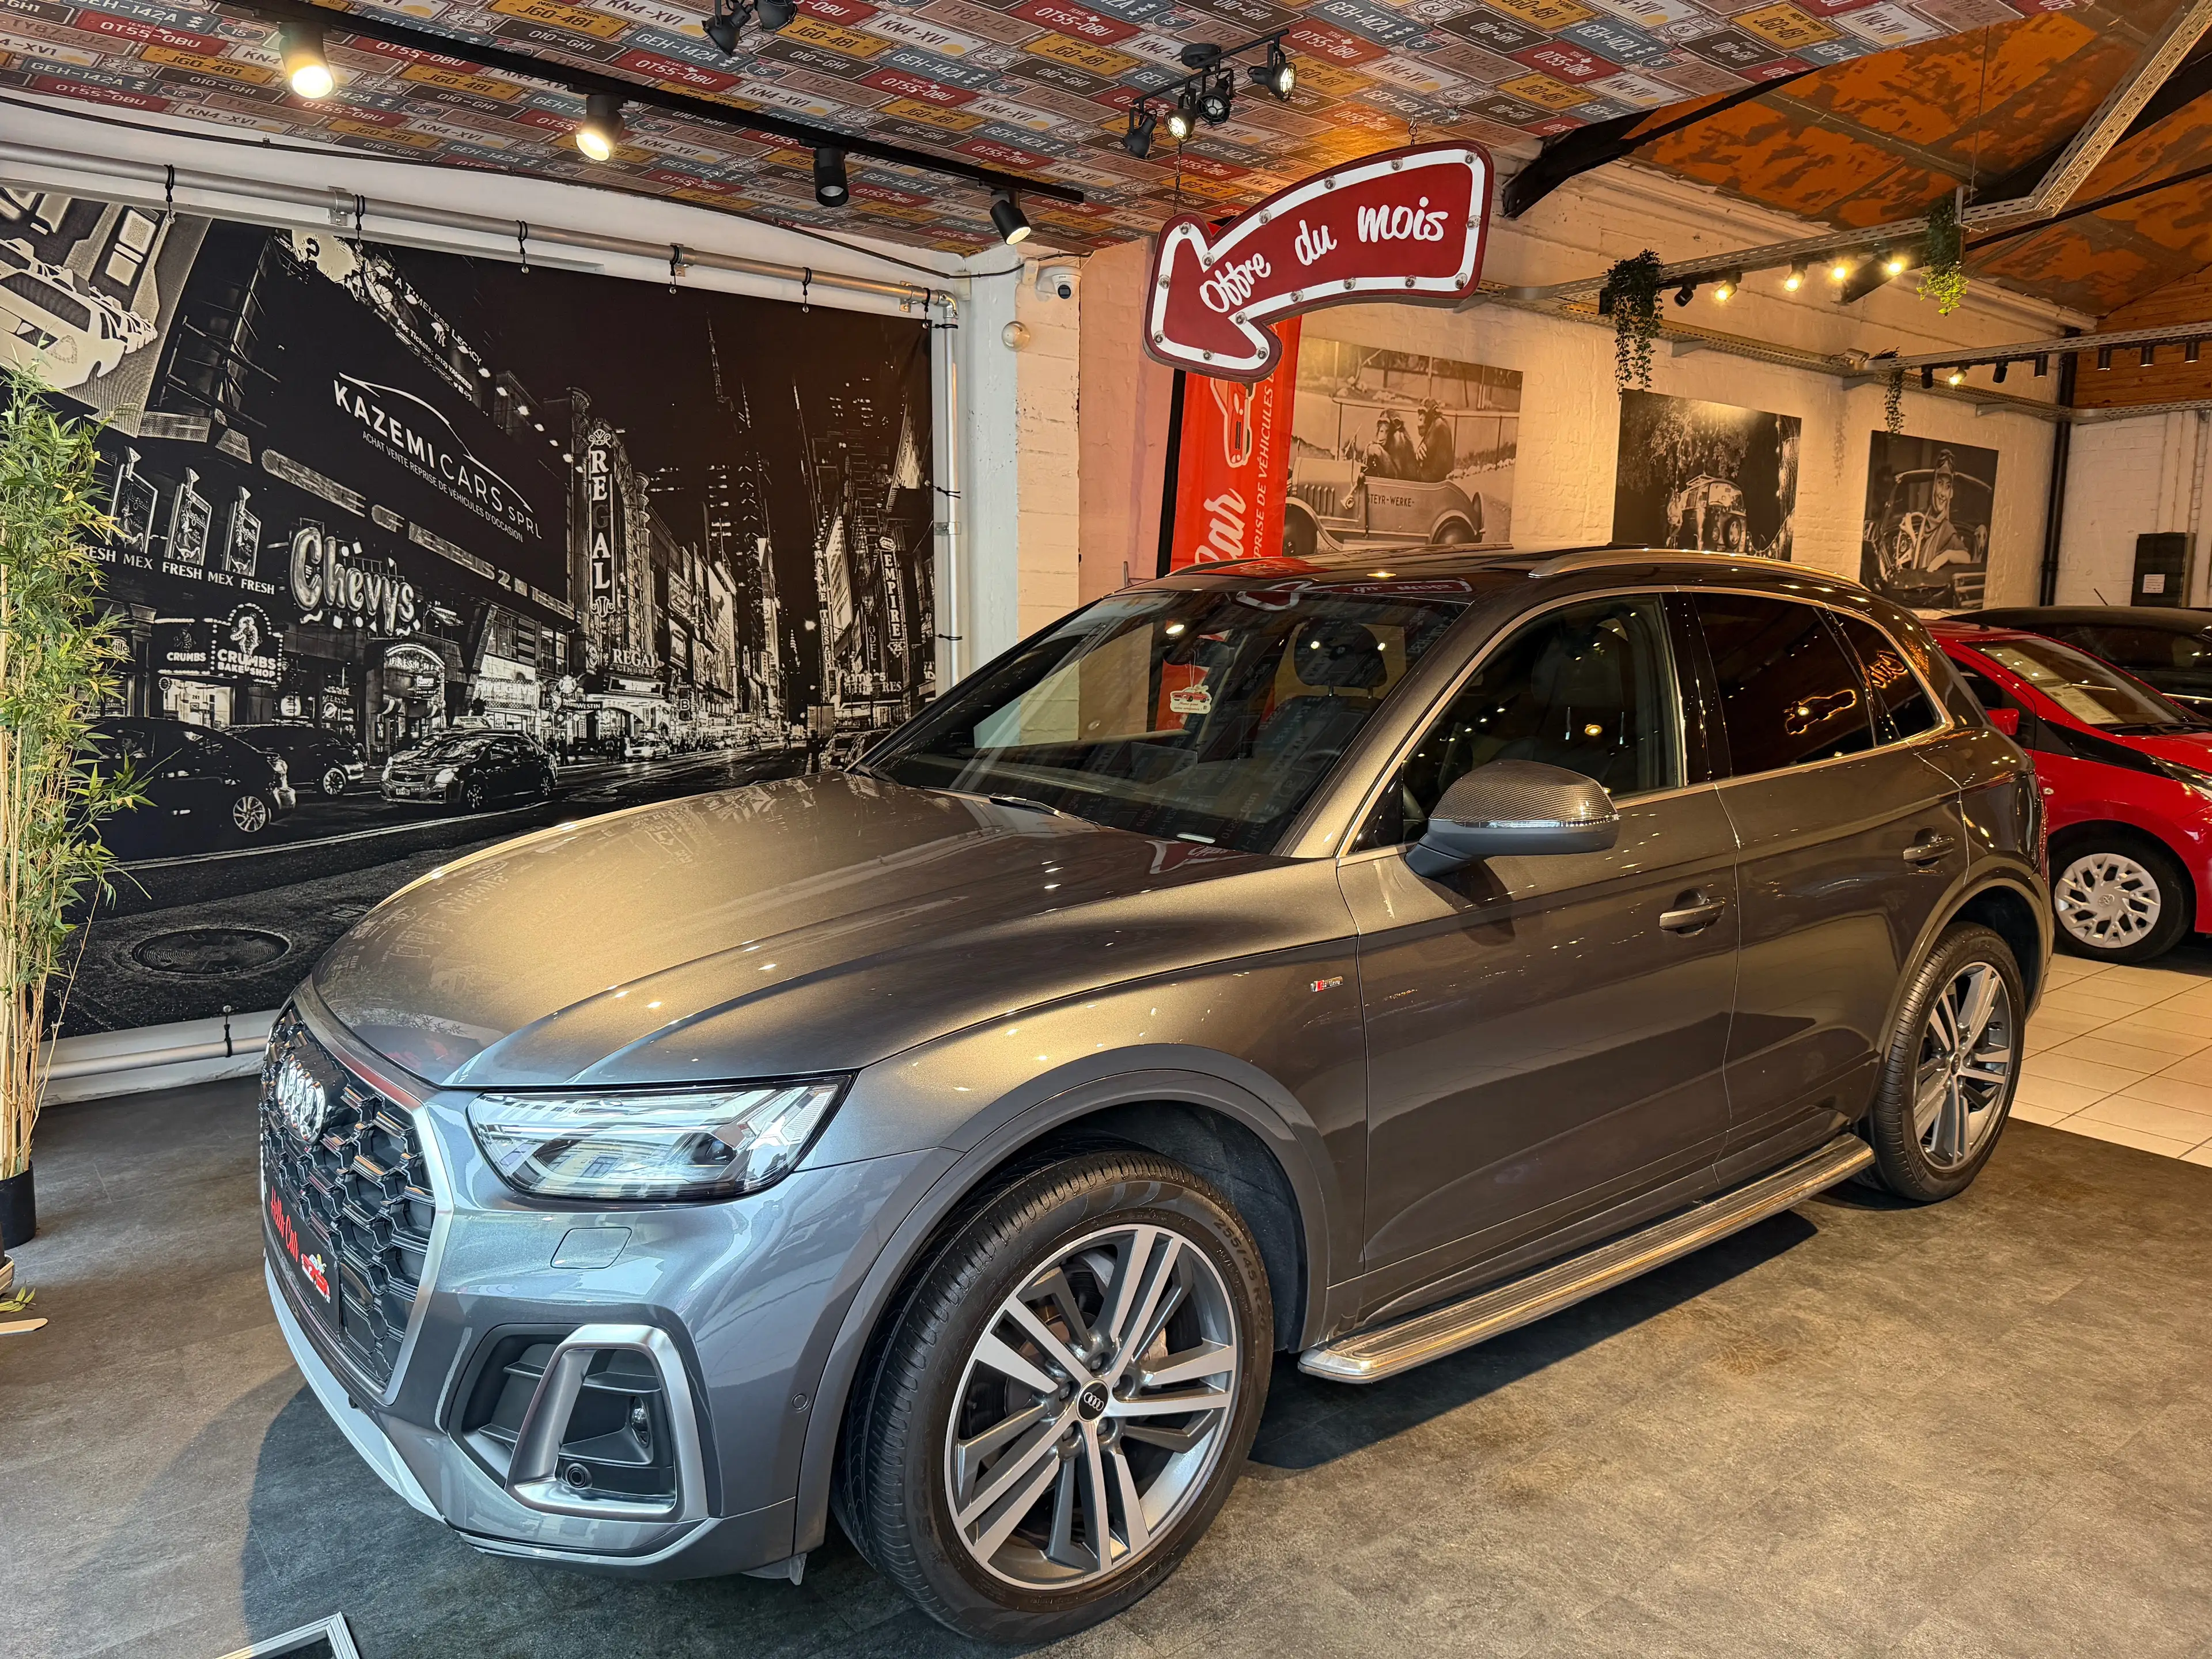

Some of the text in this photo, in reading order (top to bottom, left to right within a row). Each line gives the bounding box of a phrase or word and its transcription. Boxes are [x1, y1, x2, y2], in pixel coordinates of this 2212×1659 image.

[1069, 8, 1088, 17] TEXAS
[1160, 16, 1176, 25] 15
[1071, 41, 1094, 50] NEW
[1412, 39, 1431, 48] 15
[754, 67, 768, 75] 15
[1200, 196, 1449, 313] Offre du mois
[406, 283, 449, 331] TELESS
[1258, 386, 1274, 478] VÉHICULES
[334, 380, 542, 539] KAZEMI CARS SPRL
[363, 431, 523, 543] ACHAT VENTE REPRISE DE VÉHICULES D'OCCASION
[1256, 484, 1267, 505] DE
[123, 554, 153, 570] MEX
[162, 562, 202, 581] FRESH
[207, 571, 234, 586] MEX
[241, 578, 275, 595] FRESH
[884, 554, 901, 637] EMPIRE
[166, 652, 206, 662] CRUMBS
[218, 649, 276, 670] CRUMBS
[612, 648, 658, 668] REGAL
[250, 668, 276, 678] SHOP
[270, 1185, 300, 1263] Hello Car
